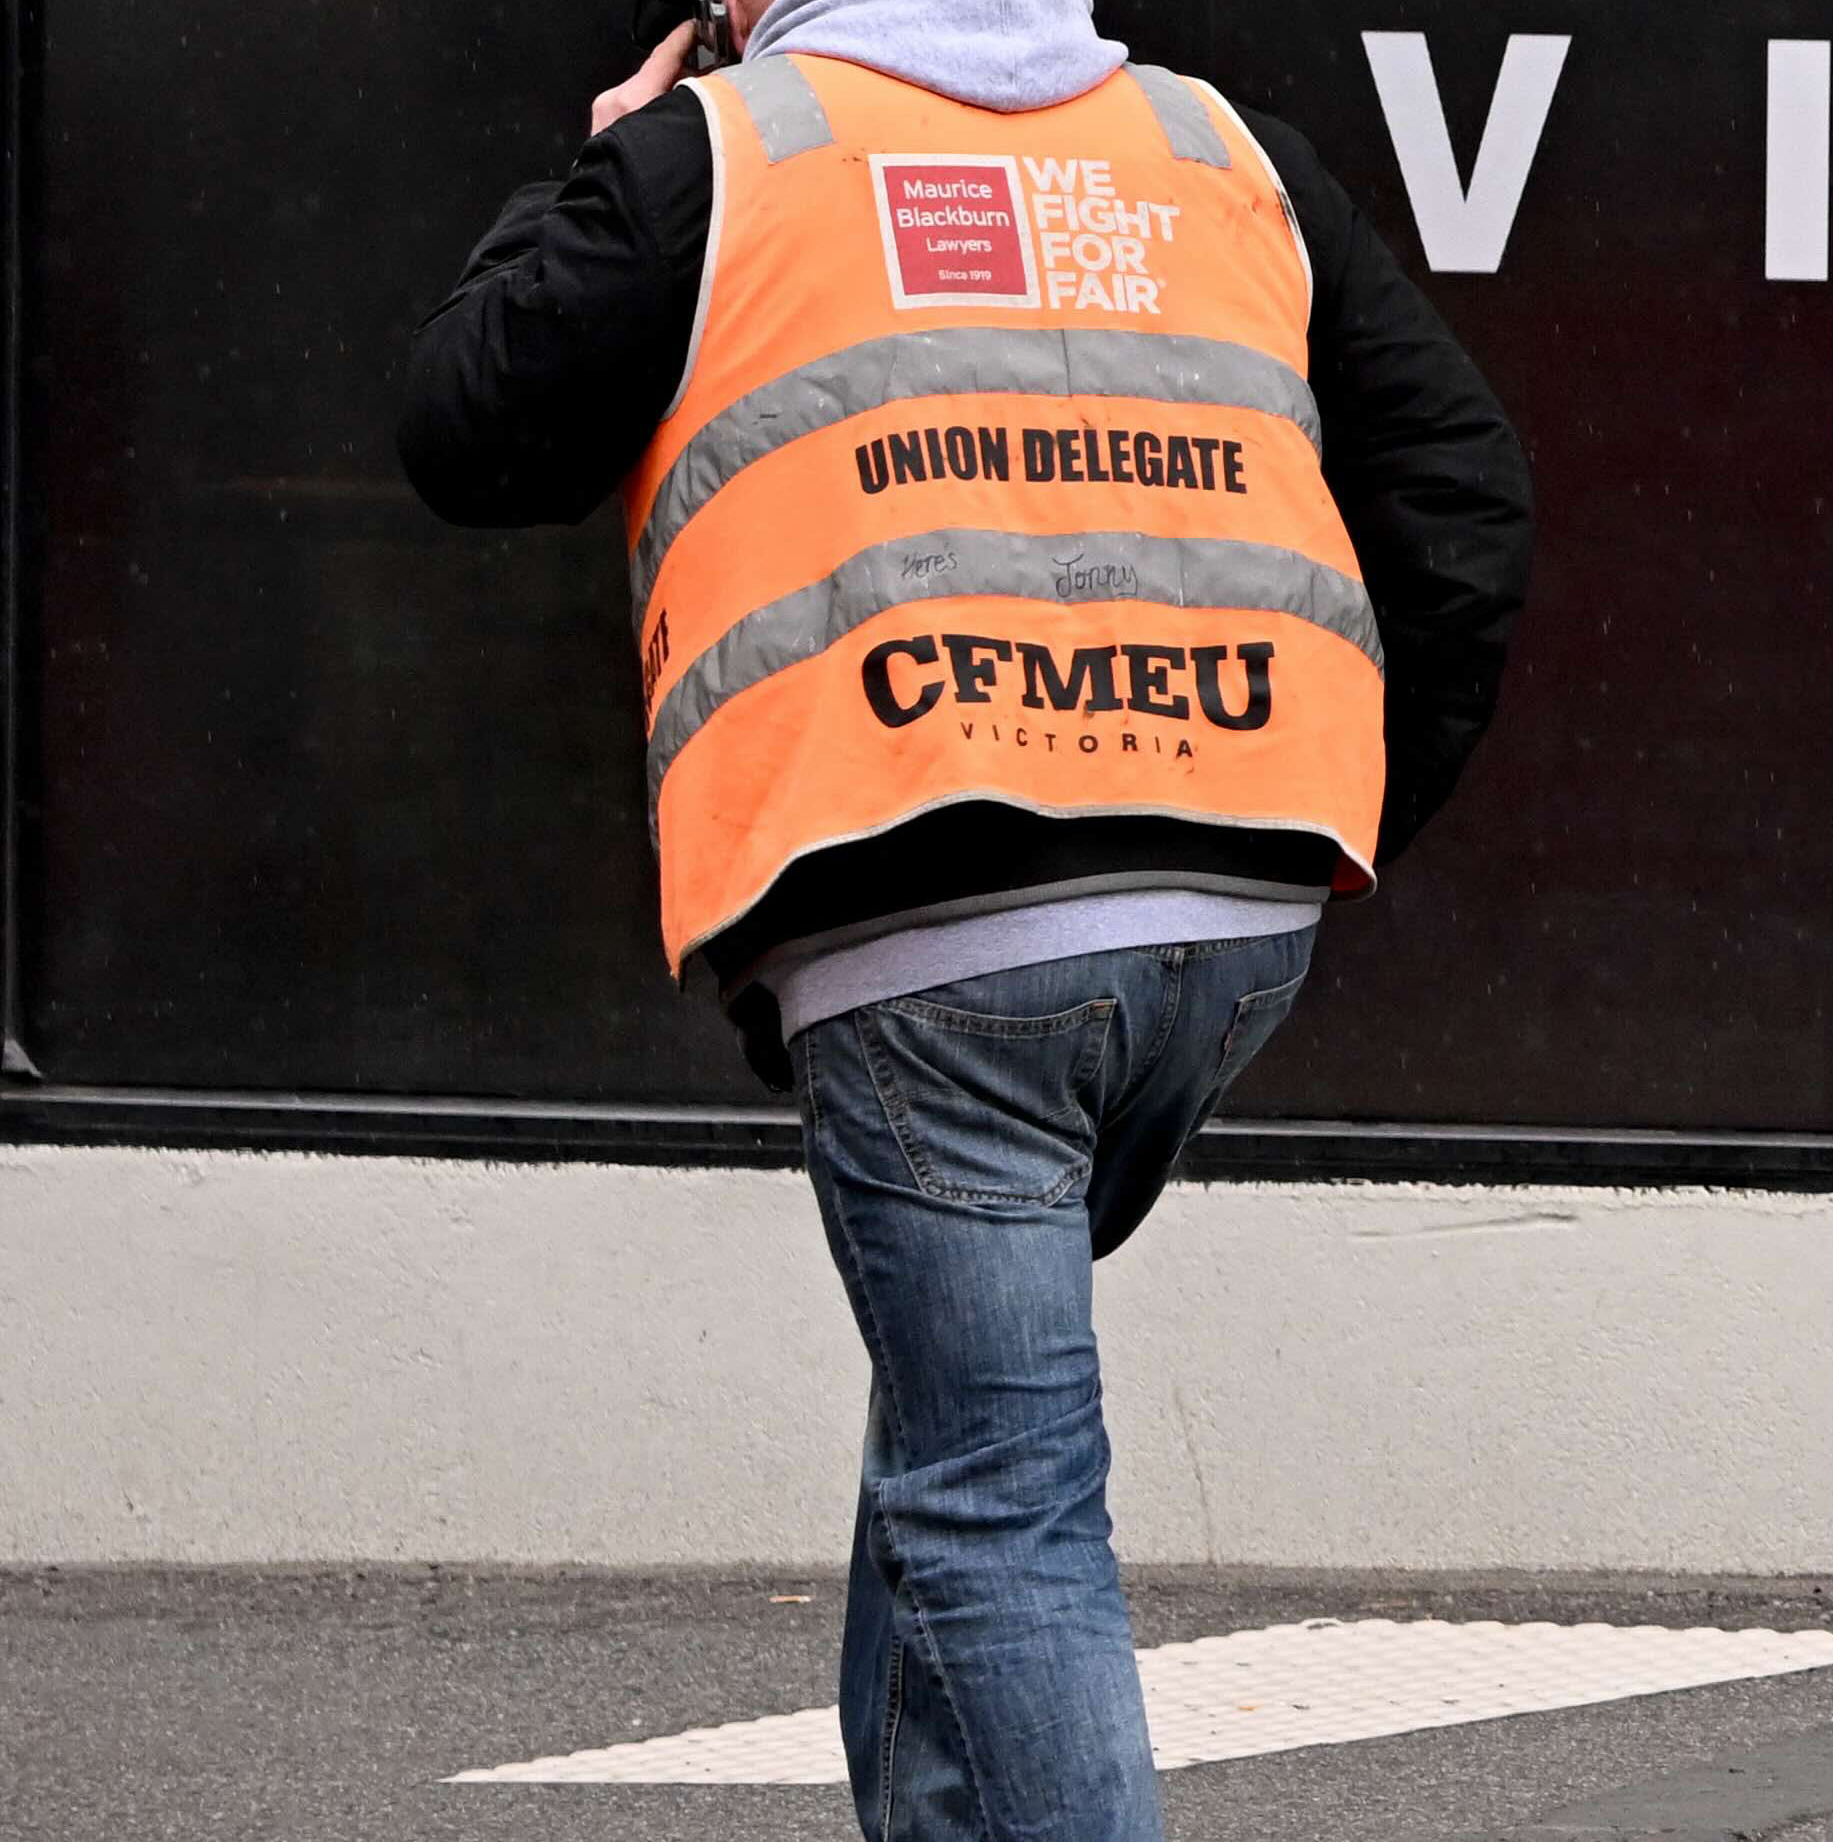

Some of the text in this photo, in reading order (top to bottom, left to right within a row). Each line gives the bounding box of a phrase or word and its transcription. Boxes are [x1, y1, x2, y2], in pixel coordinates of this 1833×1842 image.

[903, 179, 992, 199] Maurice
[1022, 156, 1116, 197] WE
[896, 206, 1010, 228] Blackburn
[1032, 194, 1180, 241] FIGHT
[926, 238, 992, 254] Lawyers
[1039, 232, 1148, 274] FOR
[938, 269, 992, 281] Since 1919
[855, 427, 1247, 494] UNION DELEGATE
[861, 634, 1275, 731] CFMEU
[960, 722, 1193, 759] VICTORIA
